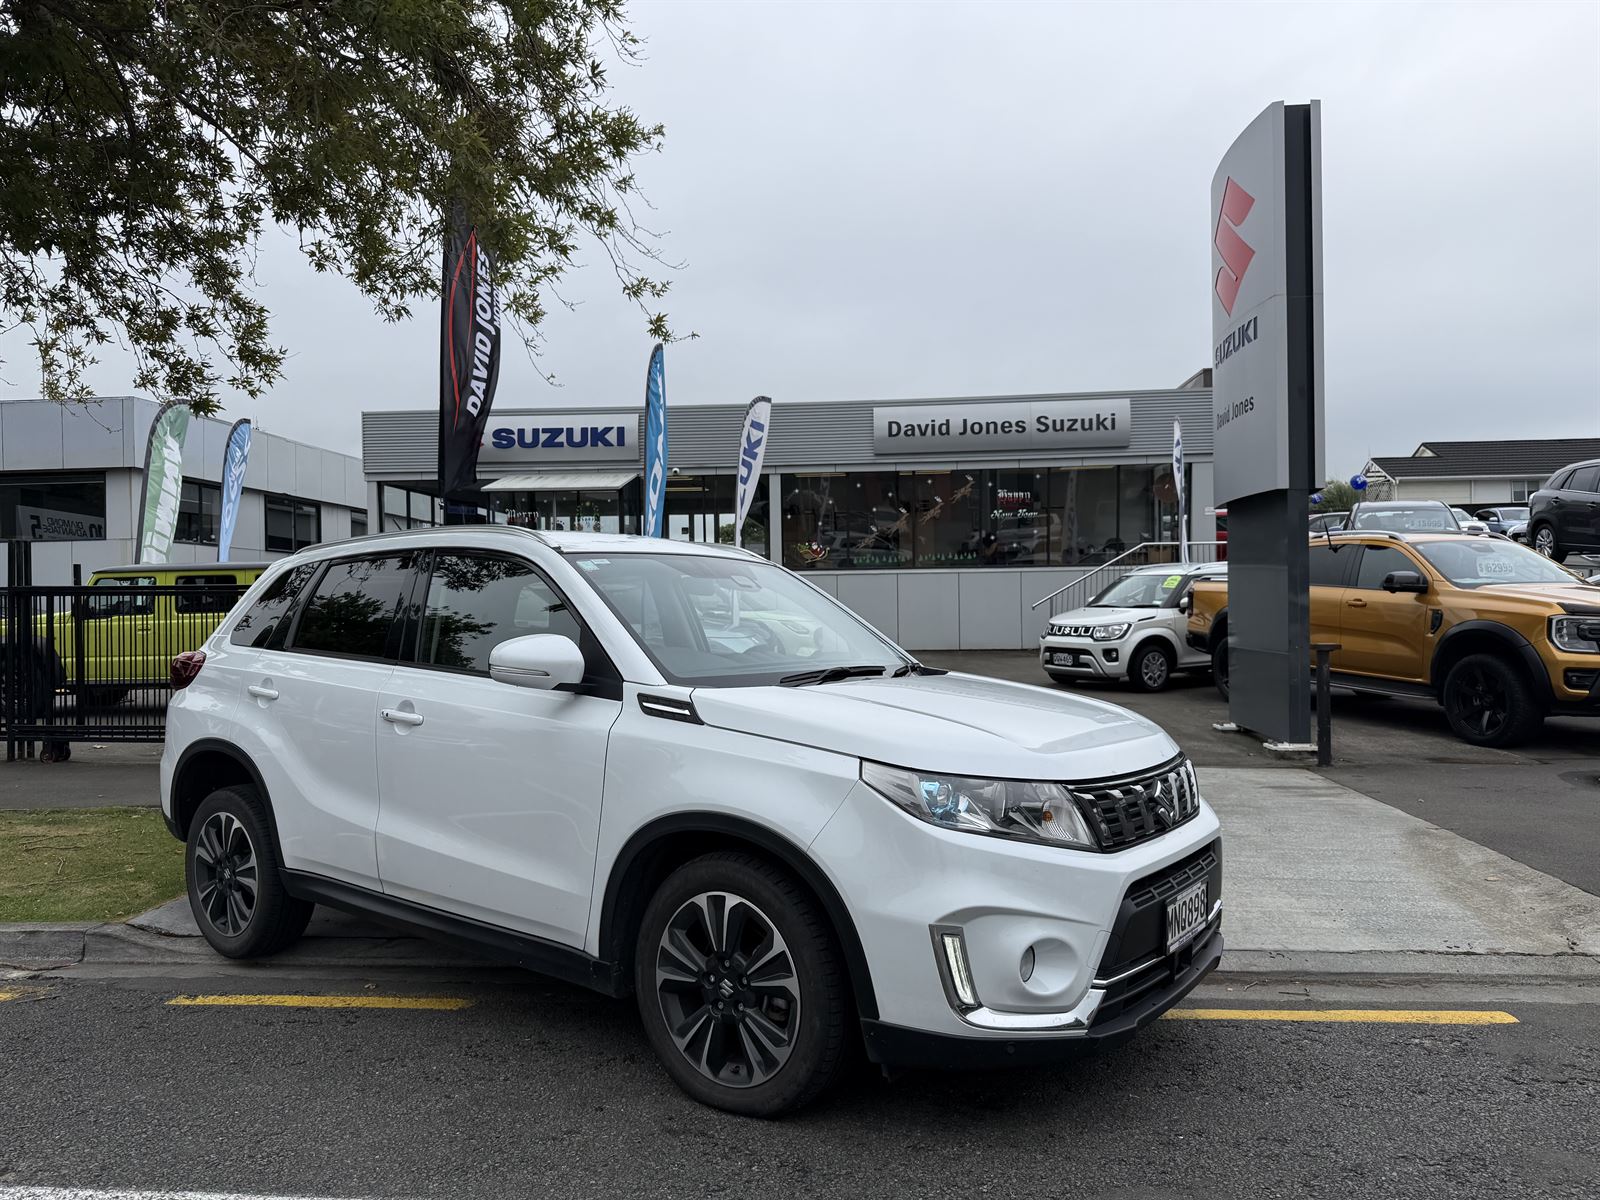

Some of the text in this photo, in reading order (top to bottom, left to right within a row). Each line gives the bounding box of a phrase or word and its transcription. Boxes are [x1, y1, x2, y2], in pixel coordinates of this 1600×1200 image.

[466, 244, 497, 418] DAVID JONES
[1214, 315, 1259, 370] SUZUKI
[887, 412, 1117, 438] David Jones Suzuki
[1216, 396, 1255, 431] David Jones
[491, 426, 626, 449] SUZUKI
[1167, 888, 1206, 940] MNQ898
